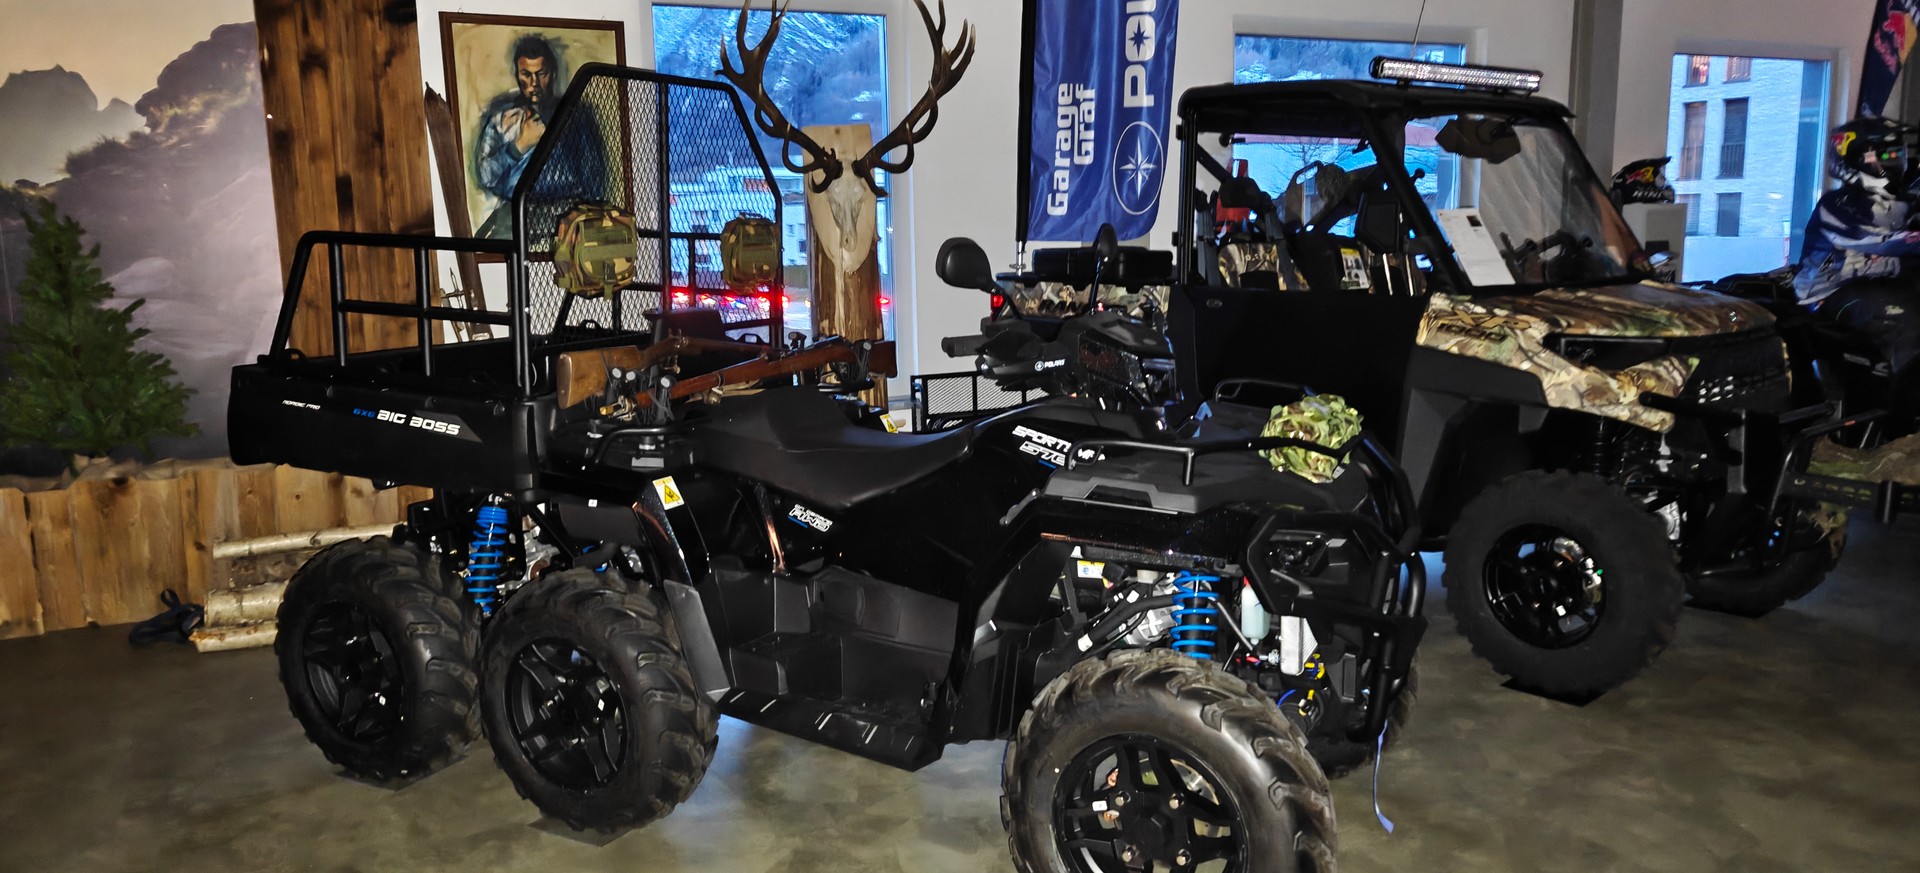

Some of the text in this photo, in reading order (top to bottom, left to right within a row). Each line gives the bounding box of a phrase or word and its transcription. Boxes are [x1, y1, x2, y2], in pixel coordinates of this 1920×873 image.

[1046, 83, 1078, 216] Garage
[1074, 83, 1096, 165] Graf
[1437, 322, 1508, 343] 1000
[377, 409, 407, 425] BIG
[409, 416, 461, 436] BOSS
